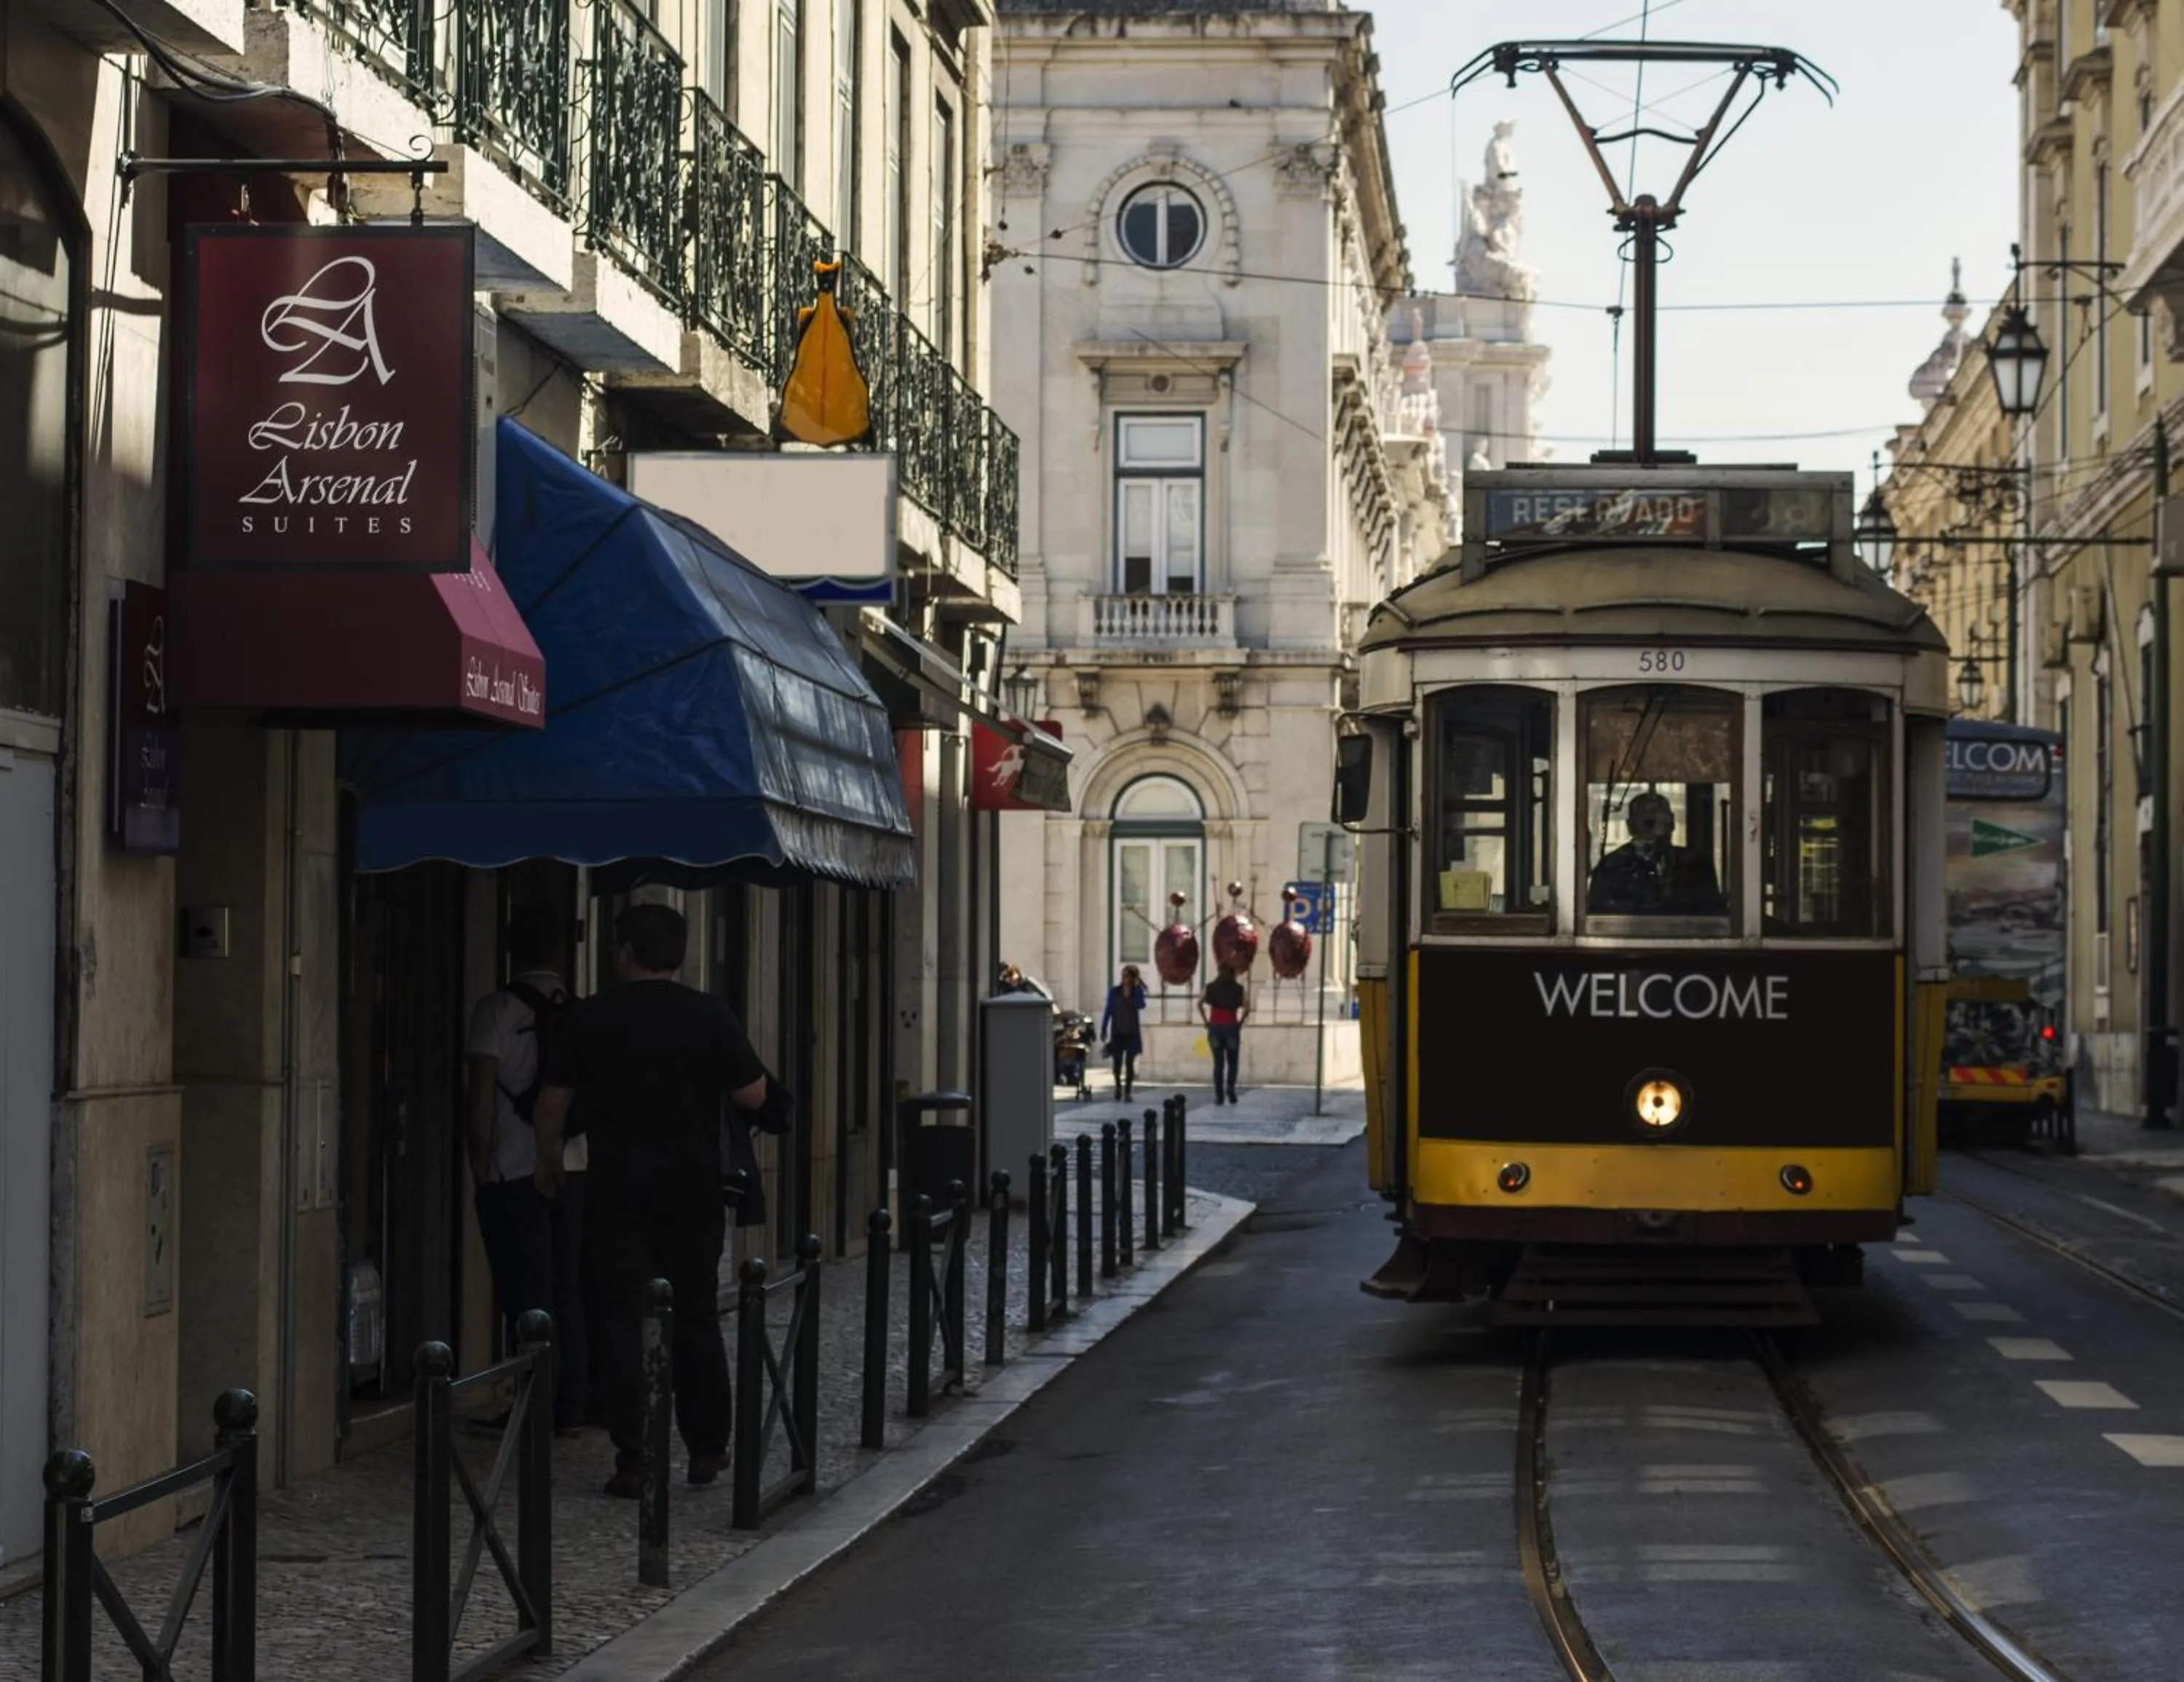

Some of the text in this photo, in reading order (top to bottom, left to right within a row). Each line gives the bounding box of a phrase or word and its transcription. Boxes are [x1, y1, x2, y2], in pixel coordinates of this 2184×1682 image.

[248, 401, 405, 450] Lisbon
[238, 454, 418, 505] Arsenal
[242, 516, 412, 534] SUITES
[1638, 651, 1685, 673] 580
[1533, 971, 1789, 1019] WELCOME
